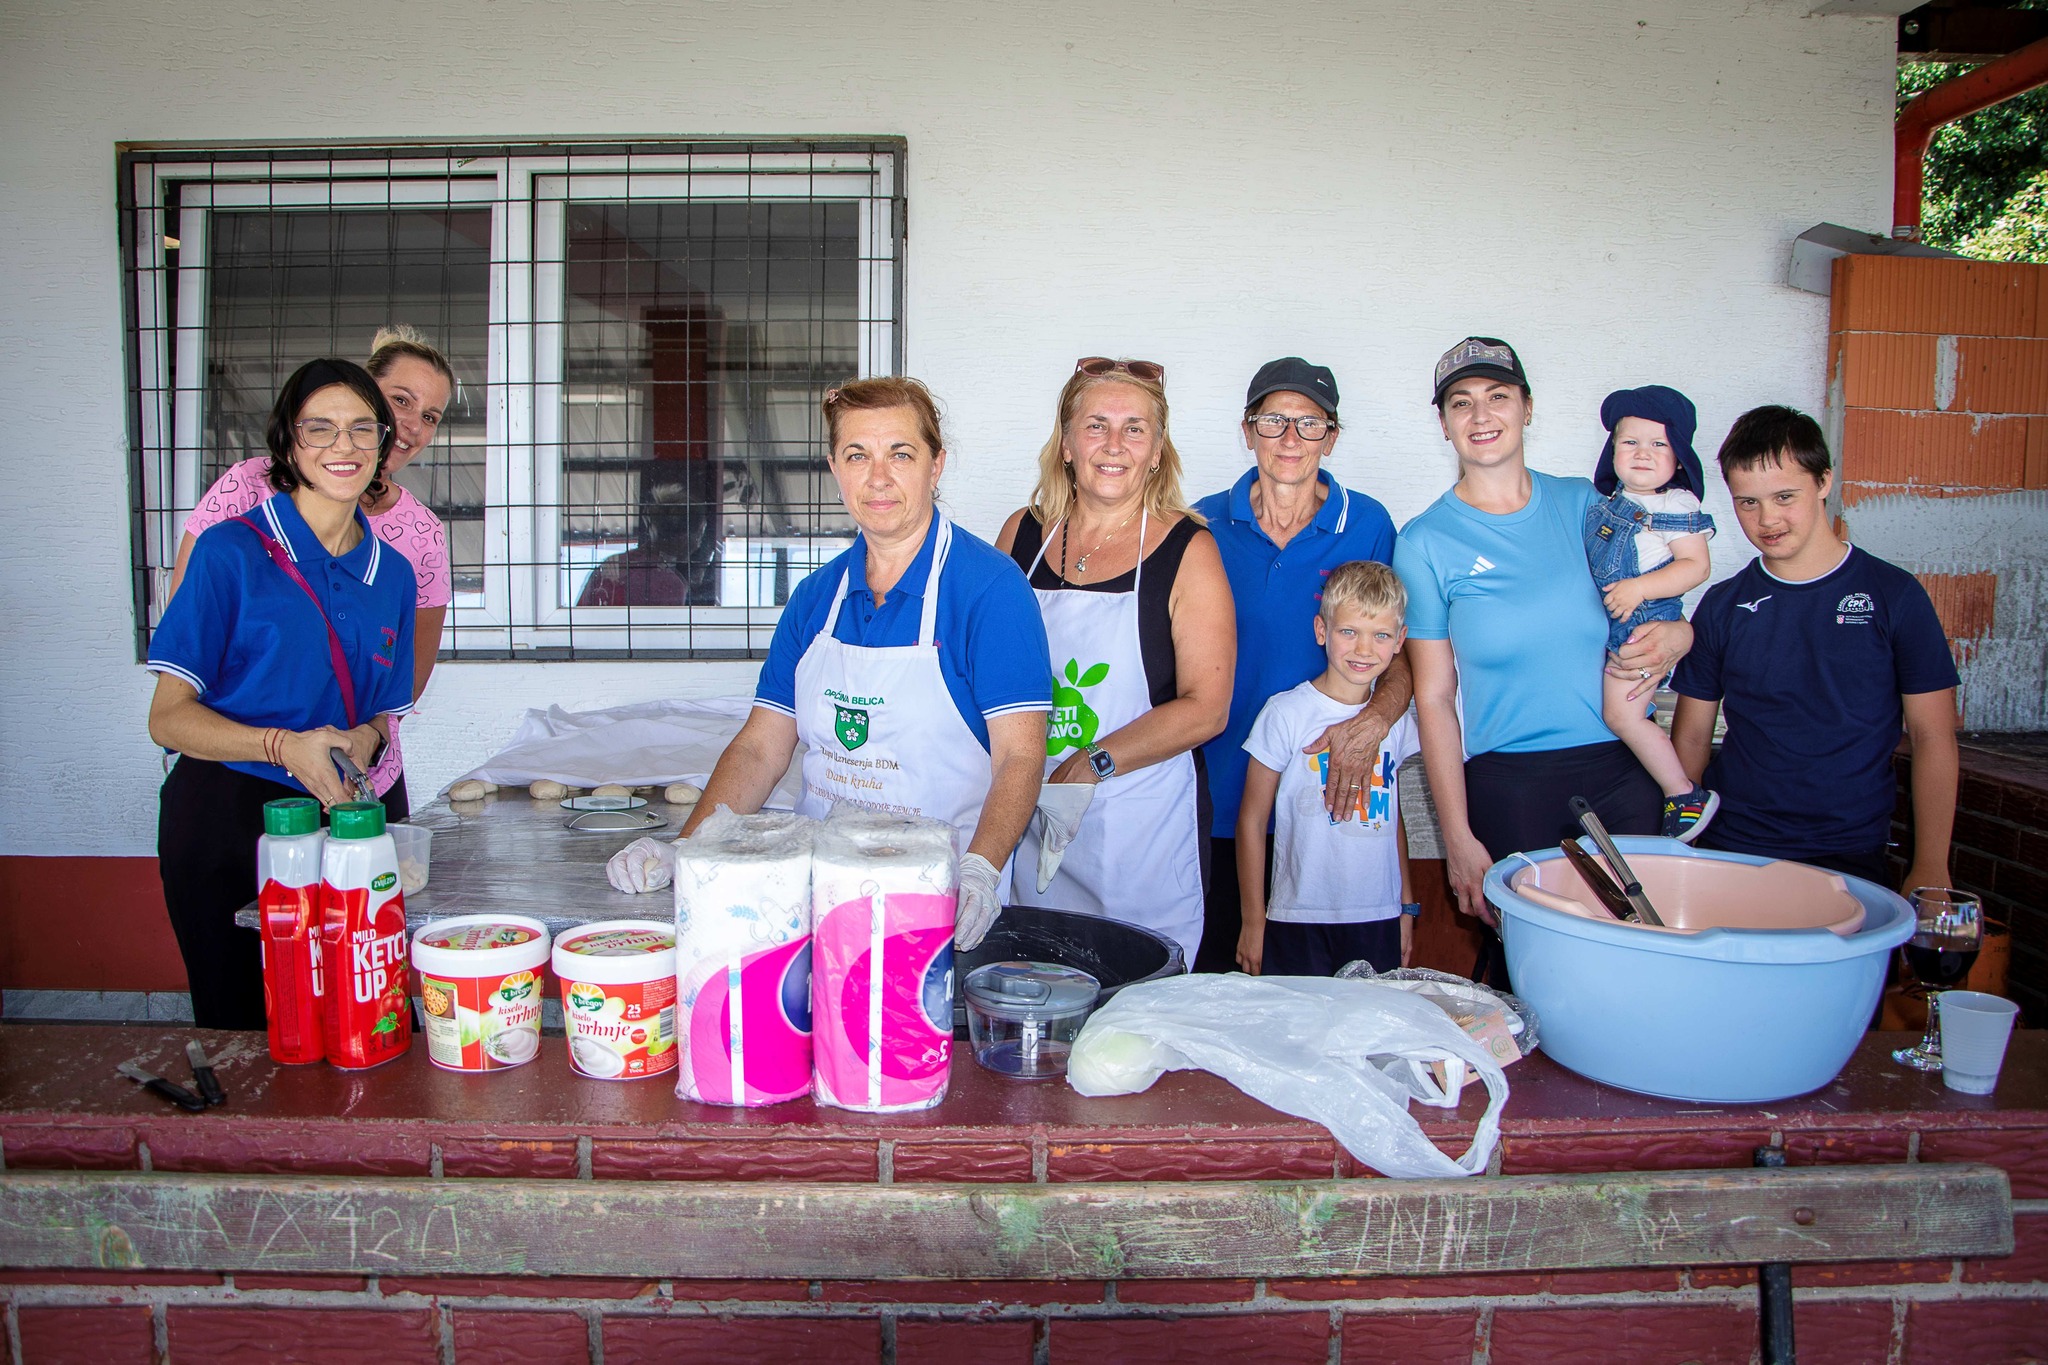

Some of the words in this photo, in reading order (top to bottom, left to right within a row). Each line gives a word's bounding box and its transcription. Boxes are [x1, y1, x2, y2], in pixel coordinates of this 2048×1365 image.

[1439, 344, 1513, 373] GUESS
[851, 696, 885, 706] BELICA
[1047, 722, 1083, 739] AVO
[875, 758, 899, 771] BDM
[825, 768, 849, 785] Dani
[850, 773, 884, 790] kruha
[352, 929, 377, 943] MILD
[354, 968, 387, 1003] UP
[498, 1002, 523, 1015] kiselo
[572, 1009, 592, 1022] kiselo
[627, 1003, 641, 1015] 25
[578, 1021, 631, 1042] vrhnje
